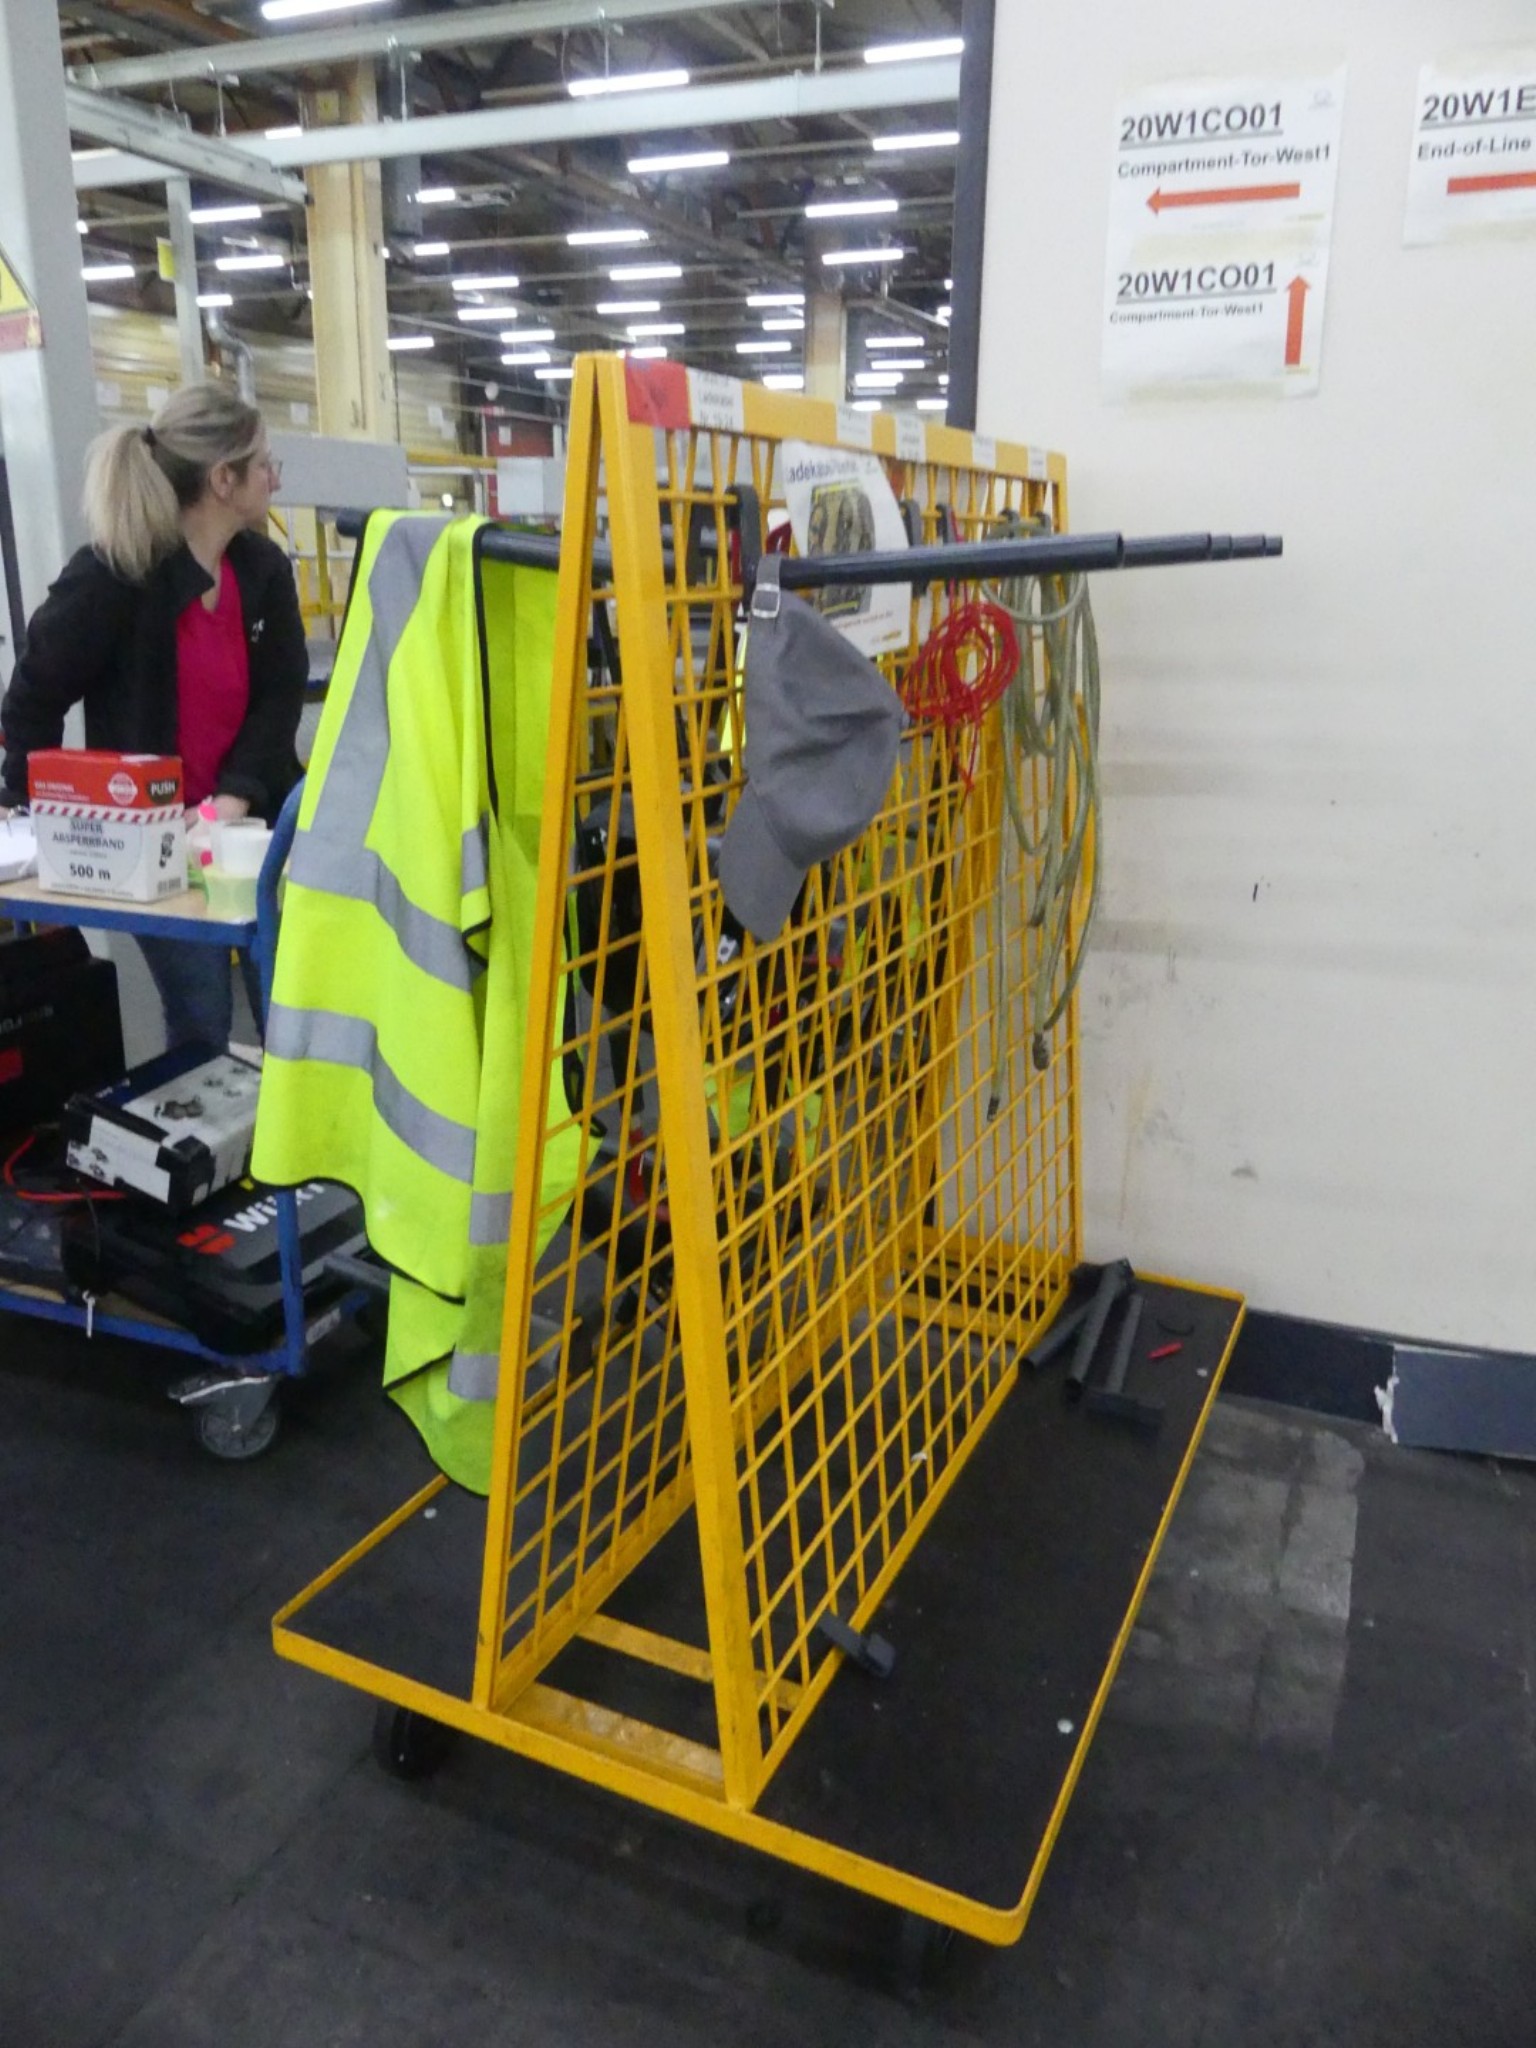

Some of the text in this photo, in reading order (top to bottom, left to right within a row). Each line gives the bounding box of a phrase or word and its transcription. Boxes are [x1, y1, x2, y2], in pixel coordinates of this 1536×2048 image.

[1120, 102, 1283, 143] 20W1CO01
[1117, 143, 1331, 179] Compartment-Tor-West1
[1417, 135, 1532, 161] End-of-Line
[1116, 262, 1277, 298] 20W1CO01
[150, 780, 177, 797] PUSH
[69, 863, 111, 880] 500 m
